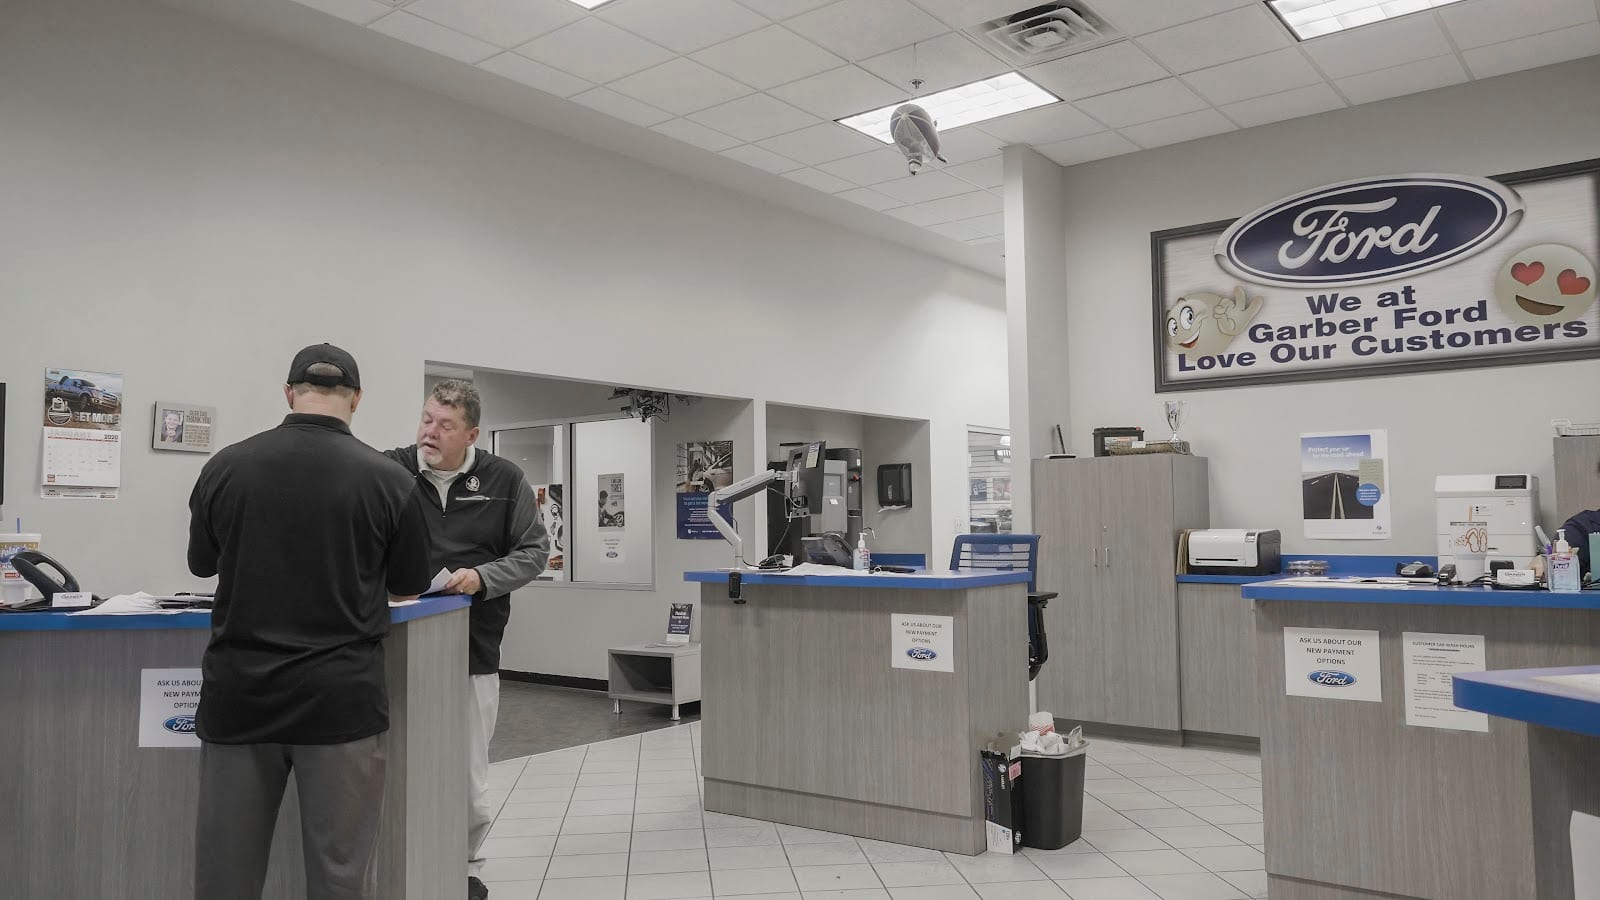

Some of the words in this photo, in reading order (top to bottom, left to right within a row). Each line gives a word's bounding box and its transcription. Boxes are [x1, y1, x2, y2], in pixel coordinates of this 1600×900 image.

[1278, 196, 1442, 269] Ford
[1305, 292, 1362, 316] We
[1376, 285, 1417, 308] at
[1247, 317, 1379, 344] Garber
[1393, 300, 1489, 330] Ford
[1177, 350, 1257, 372] Love
[1269, 342, 1337, 363] Our
[1350, 320, 1589, 357] Customers
[92, 413, 120, 425] MORE
[911, 648, 932, 659] Ford
[1316, 657, 1346, 665] OPTIONS
[1316, 671, 1348, 685] Ford
[172, 717, 196, 731] For
